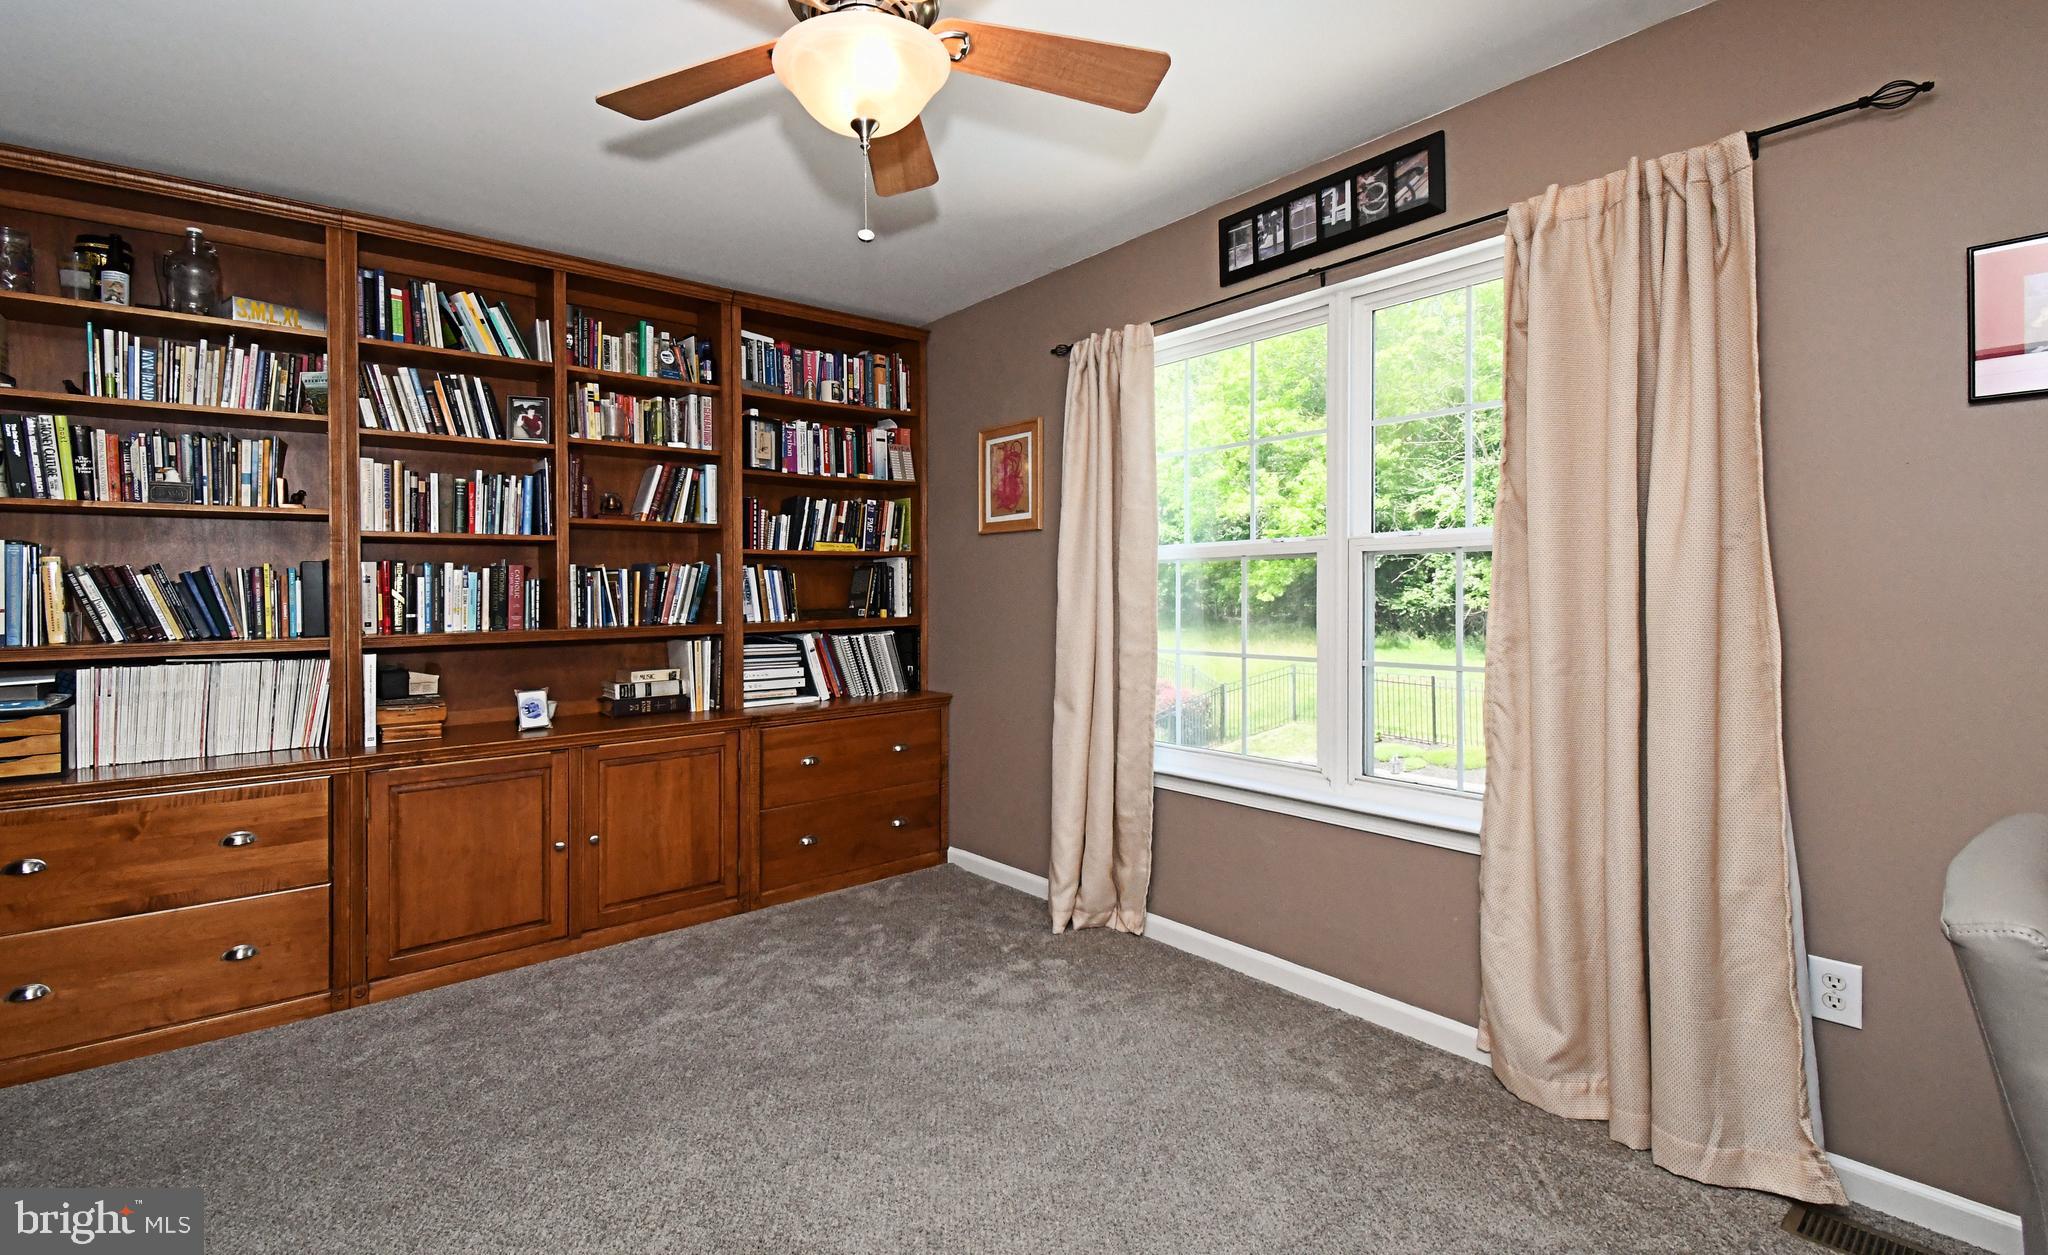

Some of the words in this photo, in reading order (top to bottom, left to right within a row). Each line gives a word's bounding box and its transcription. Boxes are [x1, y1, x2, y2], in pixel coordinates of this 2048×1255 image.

[142, 350, 154, 369] AYN
[141, 374, 155, 400] RAND
[40, 424, 54, 448] MONEY
[44, 448, 58, 477] CULTURE
